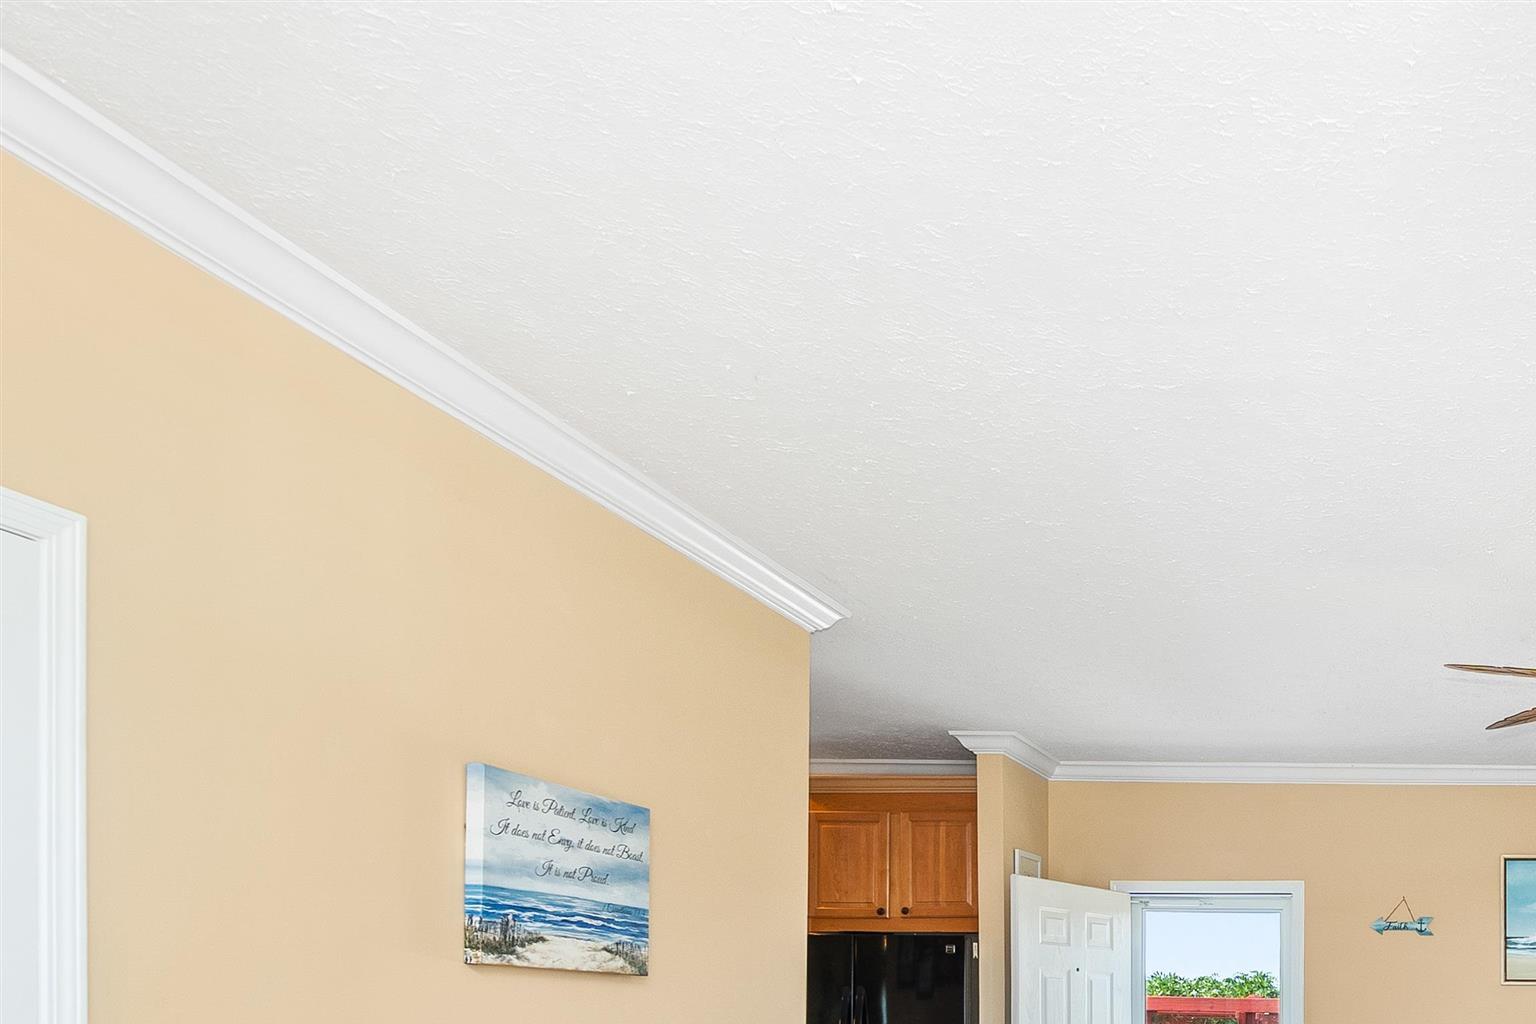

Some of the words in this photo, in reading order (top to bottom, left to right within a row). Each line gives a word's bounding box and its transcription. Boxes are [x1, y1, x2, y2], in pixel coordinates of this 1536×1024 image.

[506, 790, 531, 812] Love
[533, 801, 540, 811] is
[579, 808, 599, 828] Love
[601, 818, 608, 827] is
[609, 817, 637, 835] Kind
[490, 818, 510, 836] It
[511, 824, 529, 838] does
[532, 830, 547, 841] not
[585, 840, 601, 853] does
[602, 845, 614, 856] not
[535, 860, 554, 877] It
[563, 868, 577, 879] not
[1383, 920, 1409, 931] Faith
